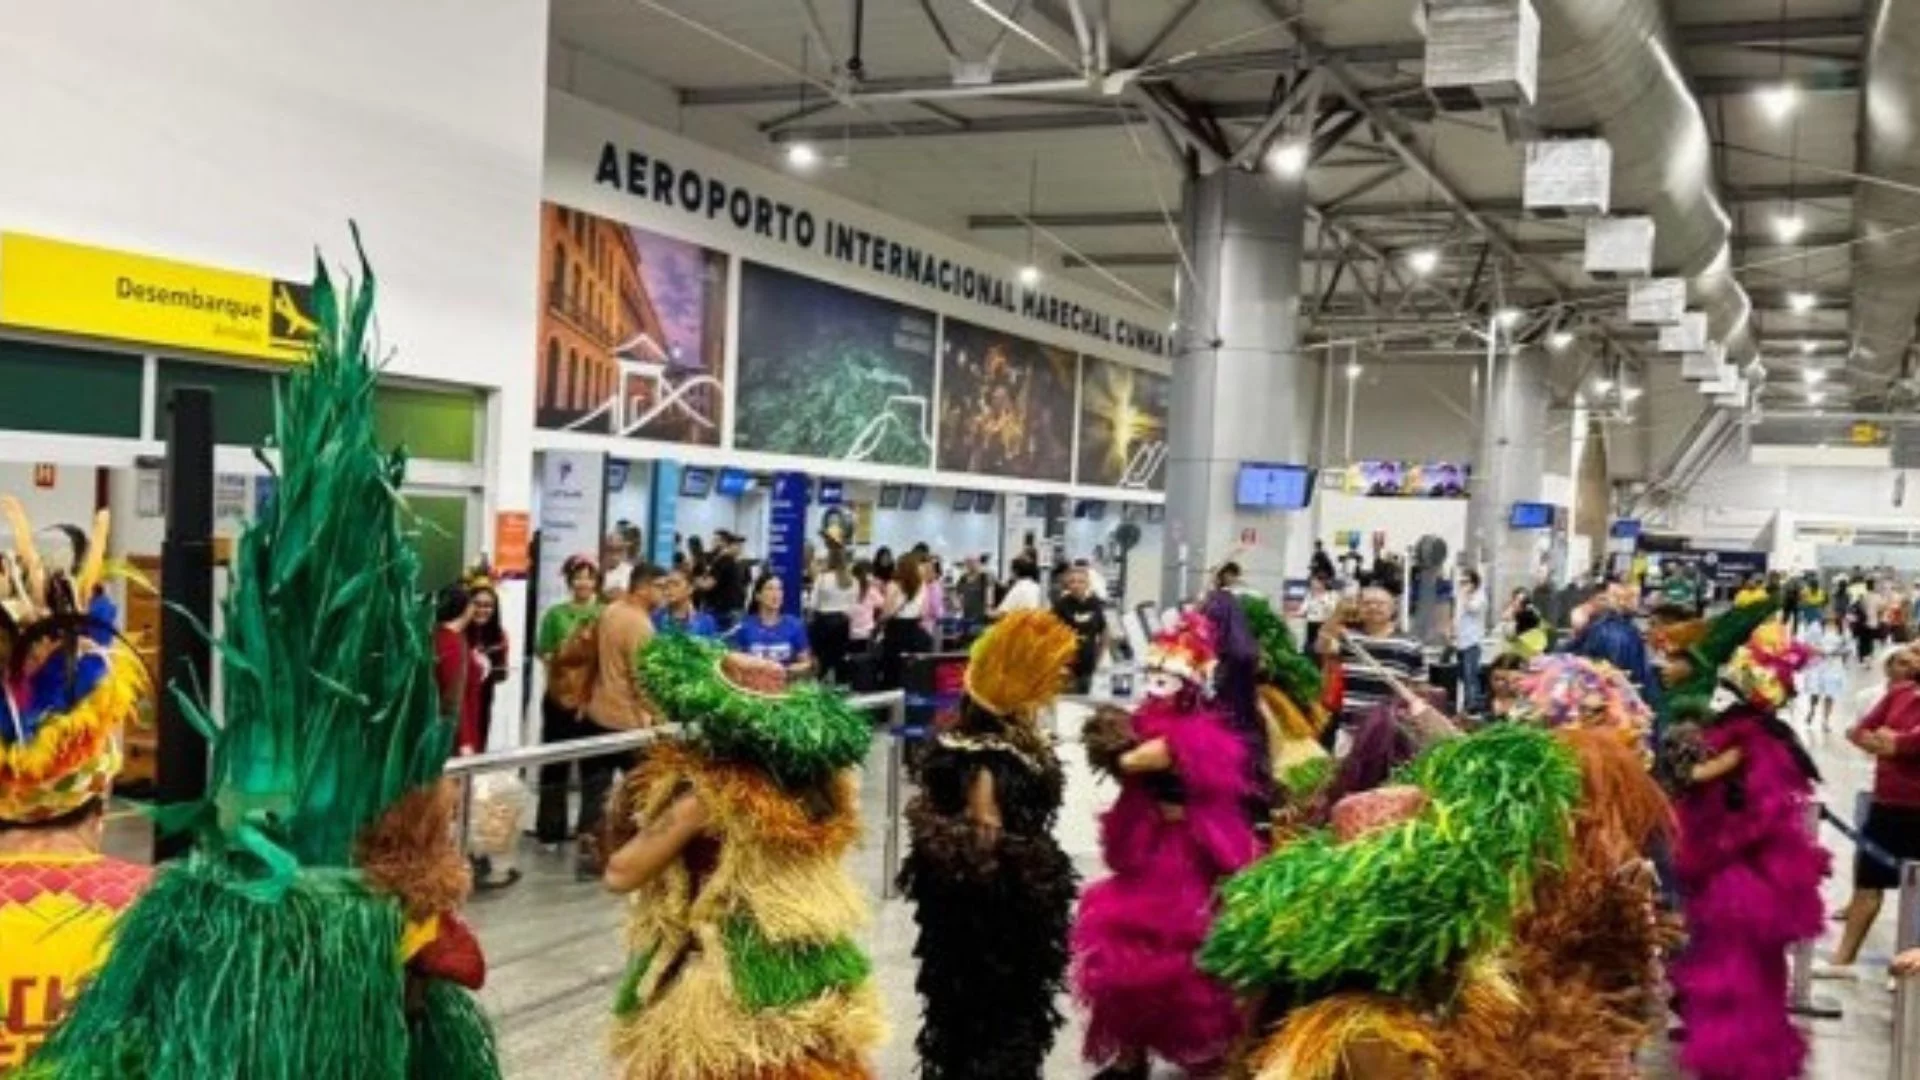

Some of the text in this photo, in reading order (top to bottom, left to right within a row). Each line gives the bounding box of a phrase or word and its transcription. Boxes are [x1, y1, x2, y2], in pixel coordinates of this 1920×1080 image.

[116, 276, 263, 320] Desembarque
[595, 140, 815, 248] AEROPORTO
[825, 219, 1016, 314] INTERNACIONAL
[1023, 287, 1111, 342] MARECHAL
